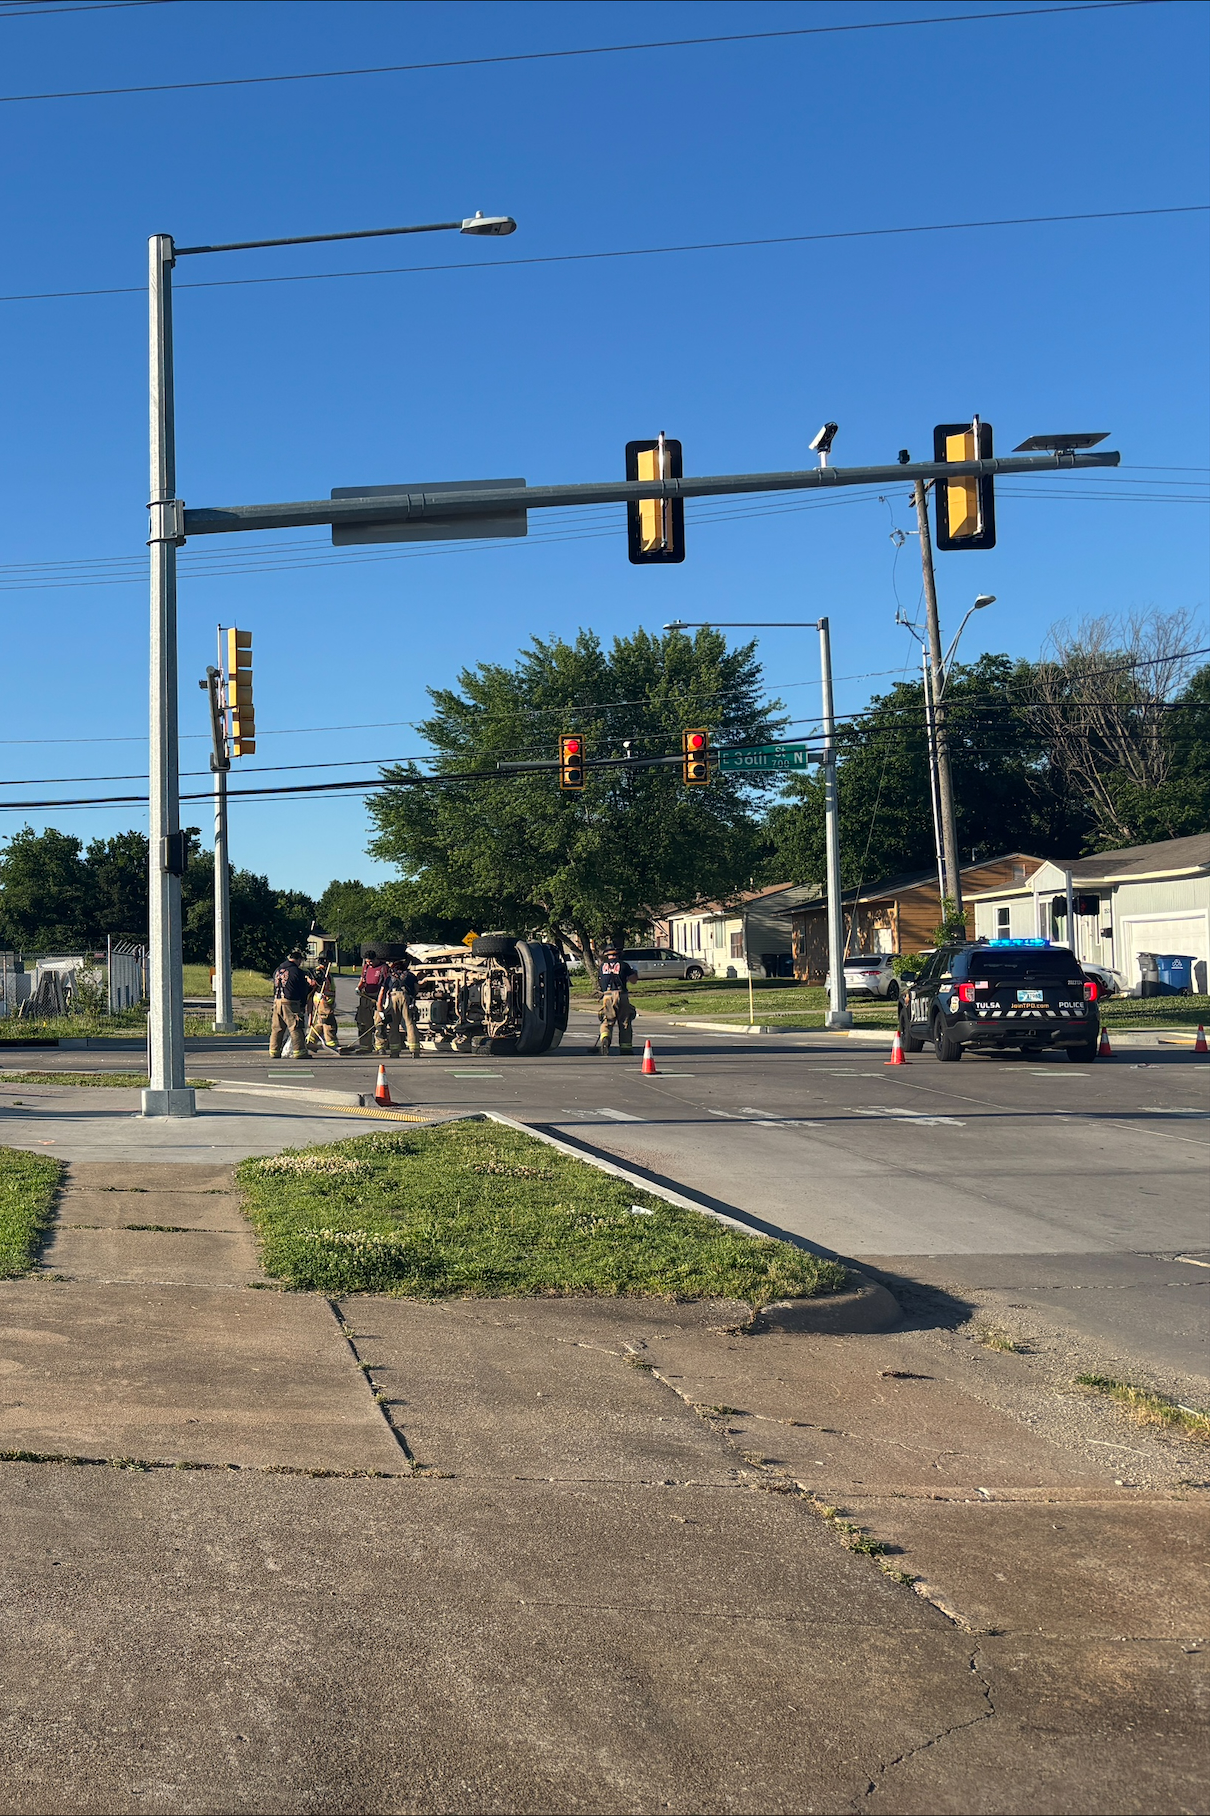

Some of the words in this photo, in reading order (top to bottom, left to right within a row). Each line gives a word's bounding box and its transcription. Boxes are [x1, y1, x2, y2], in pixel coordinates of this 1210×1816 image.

[723, 753, 729, 764] E
[734, 751, 767, 766] 36th
[774, 746, 786, 757] St
[794, 752, 803, 764] N
[975, 1001, 1001, 1009] TULSA
[1058, 1001, 1084, 1009] POLICE
